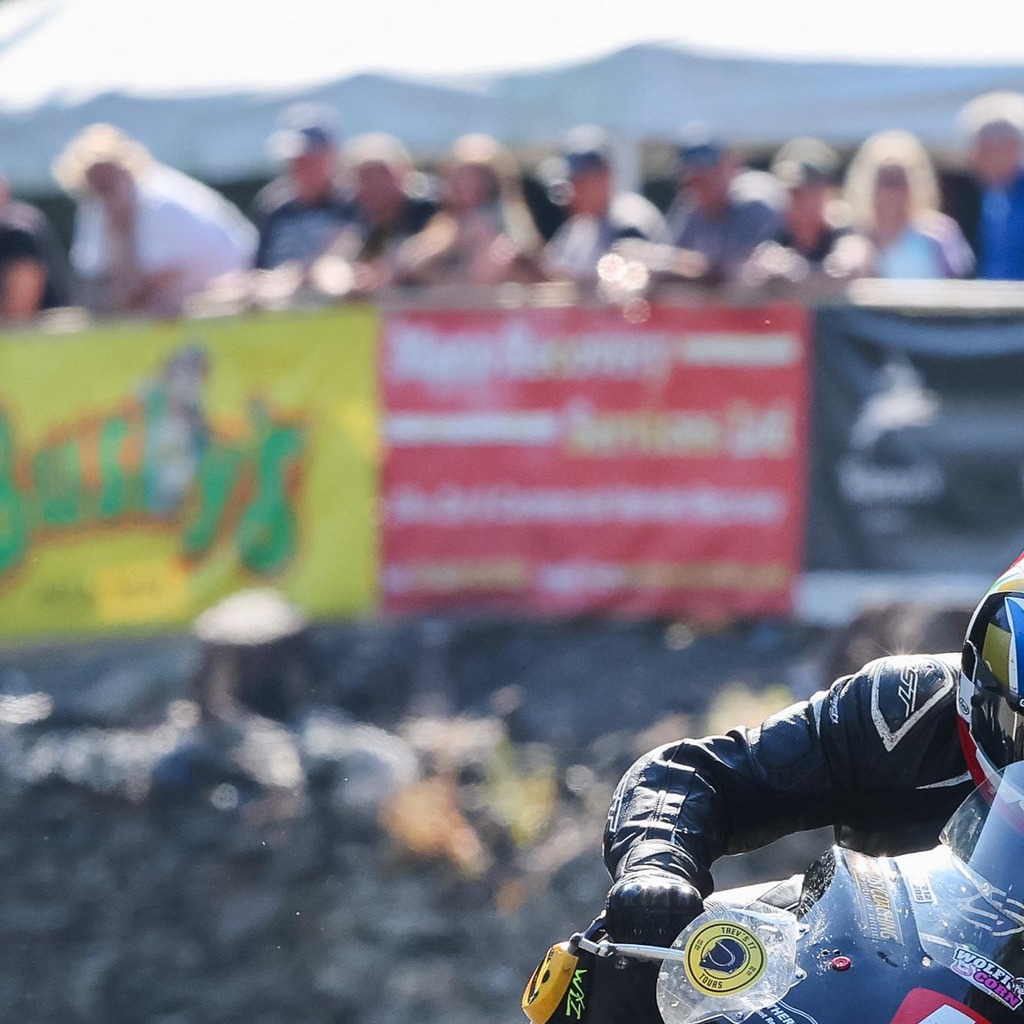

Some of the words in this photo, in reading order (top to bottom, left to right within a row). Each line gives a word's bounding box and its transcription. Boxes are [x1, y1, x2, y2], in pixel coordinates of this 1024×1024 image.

[721, 927, 749, 942] TREV'S
[699, 973, 723, 989] TOURS
[973, 970, 1021, 1007] CORN
